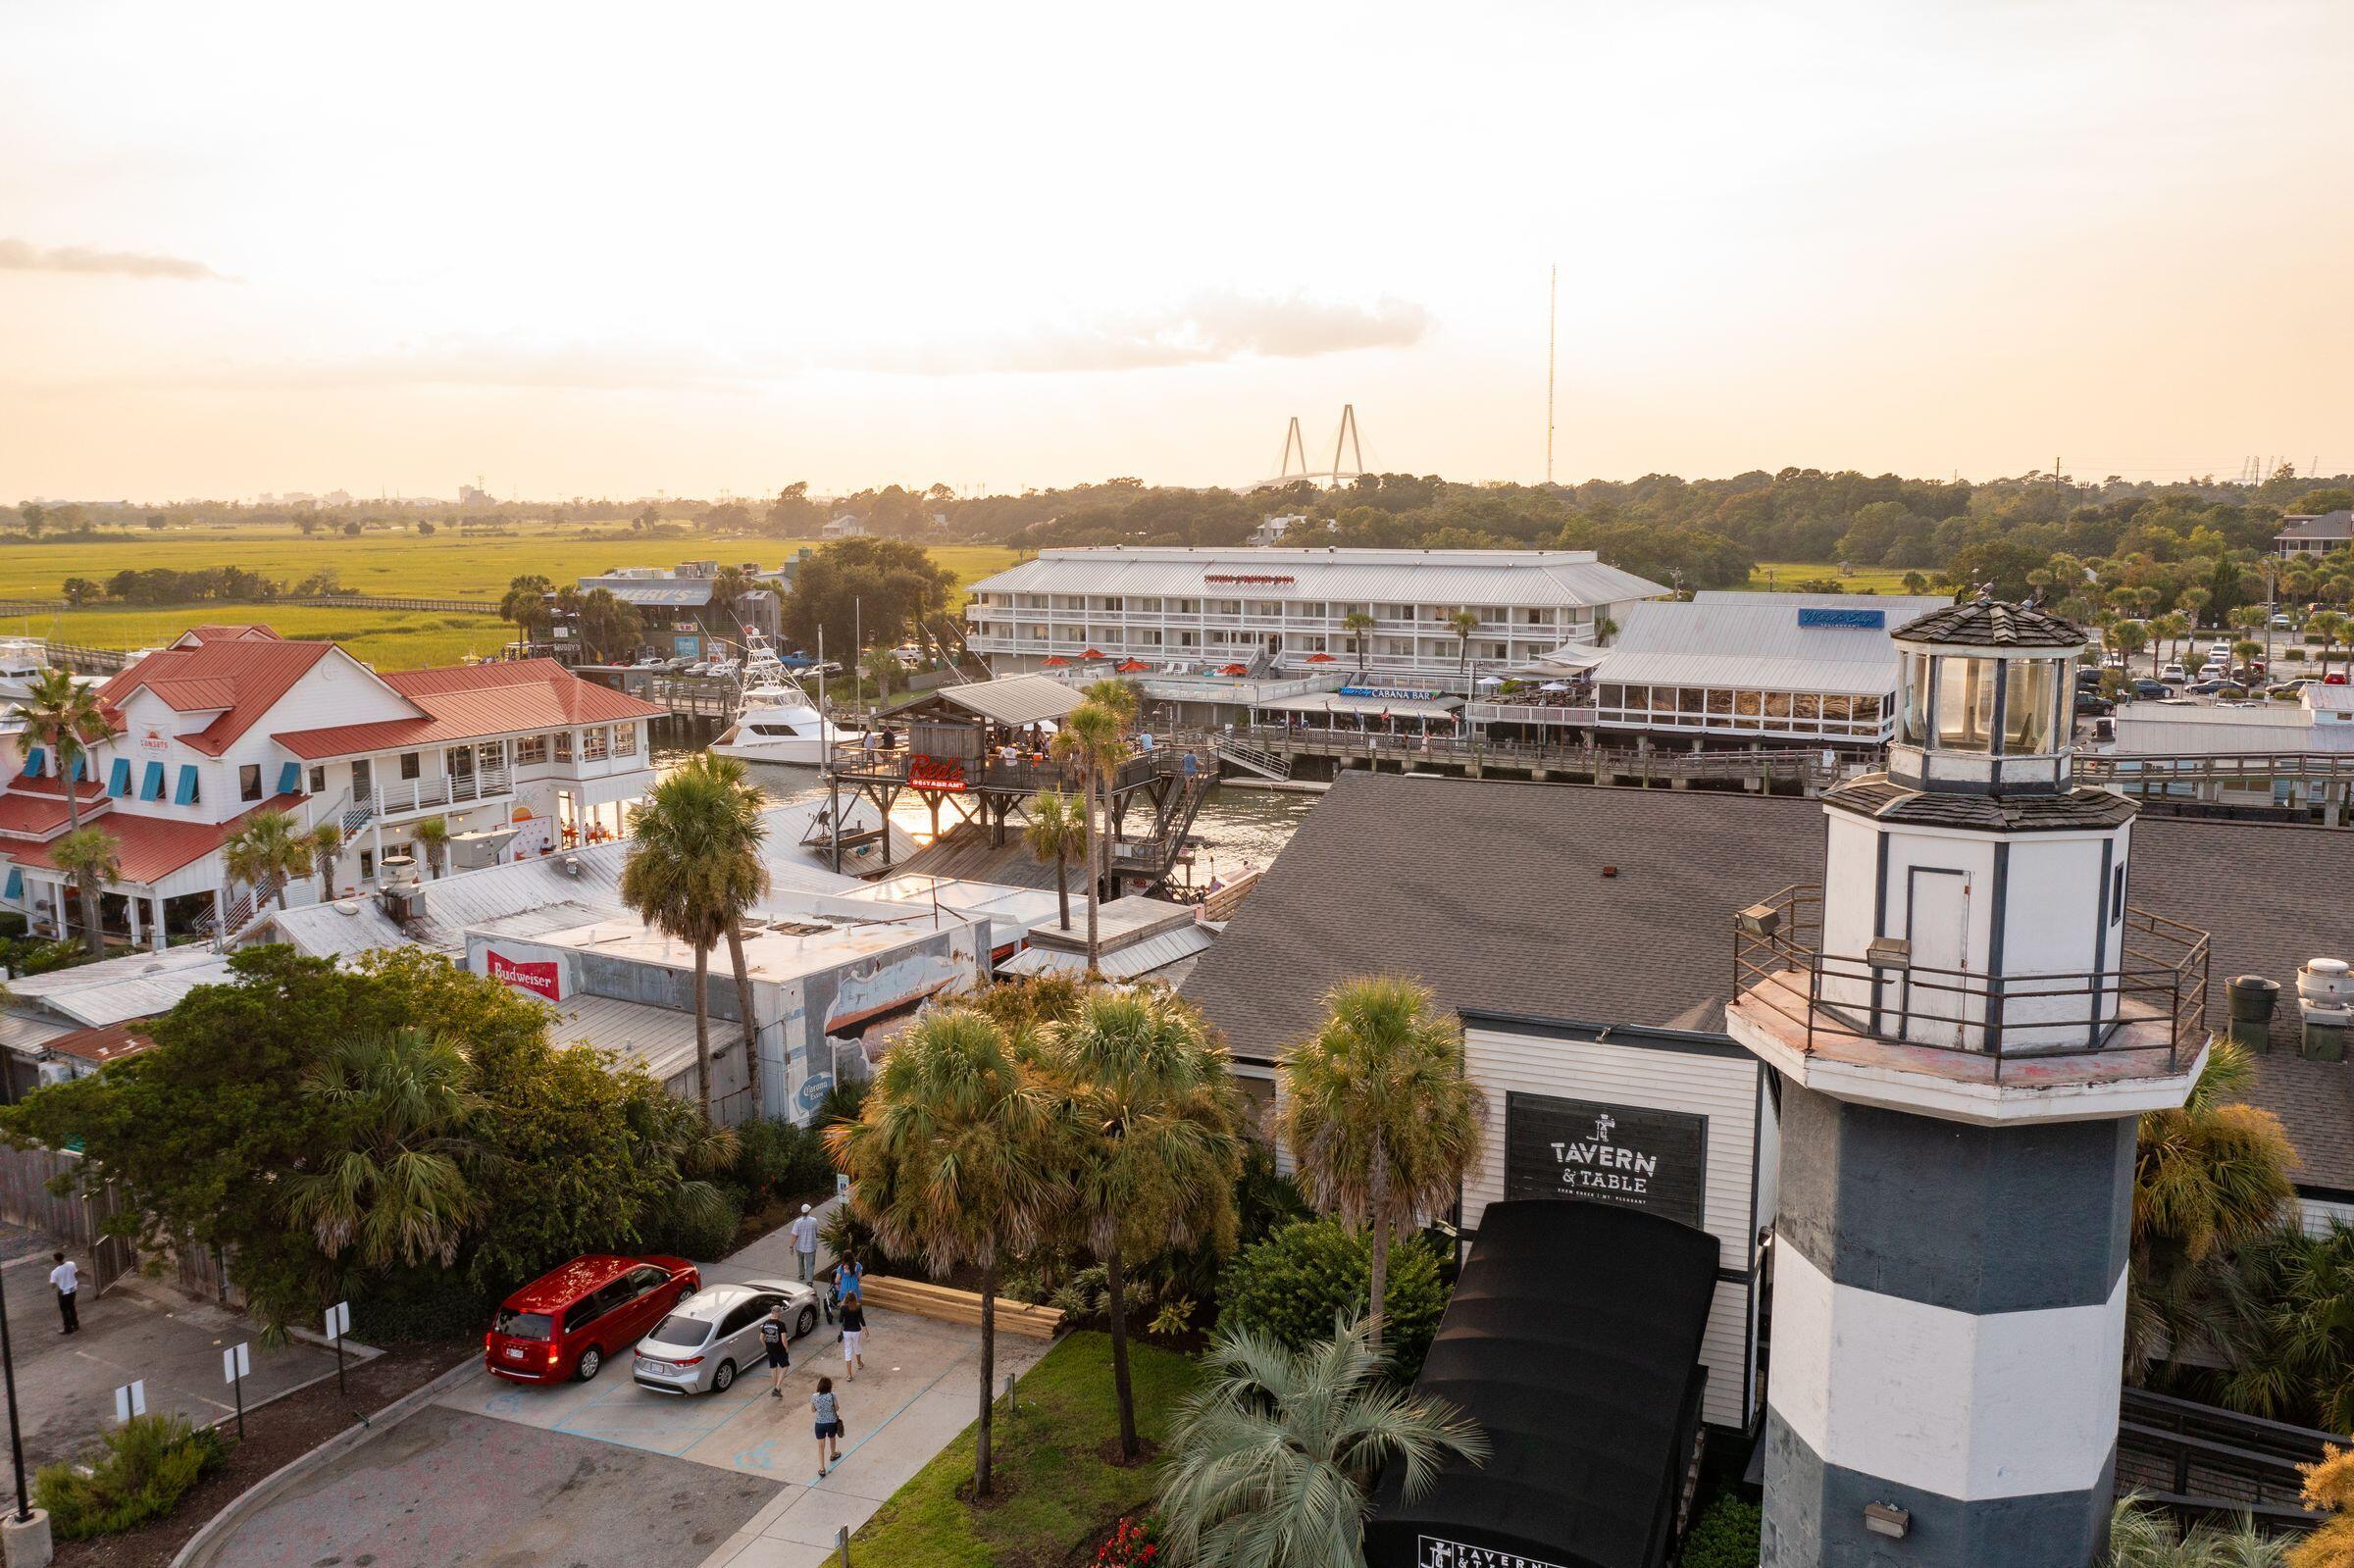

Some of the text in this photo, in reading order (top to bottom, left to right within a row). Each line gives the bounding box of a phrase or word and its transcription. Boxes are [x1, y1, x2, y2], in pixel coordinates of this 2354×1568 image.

[1371, 689, 1409, 699] CABANA
[1412, 691, 1430, 700] BAR
[909, 753, 965, 781] Red's
[912, 780, 964, 788] RESTAURANT
[493, 962, 551, 988] Budweiser
[804, 1081, 828, 1097] Corona
[1551, 1142, 1658, 1178] TAVERN
[1562, 1168, 1647, 1193] & TABLE
